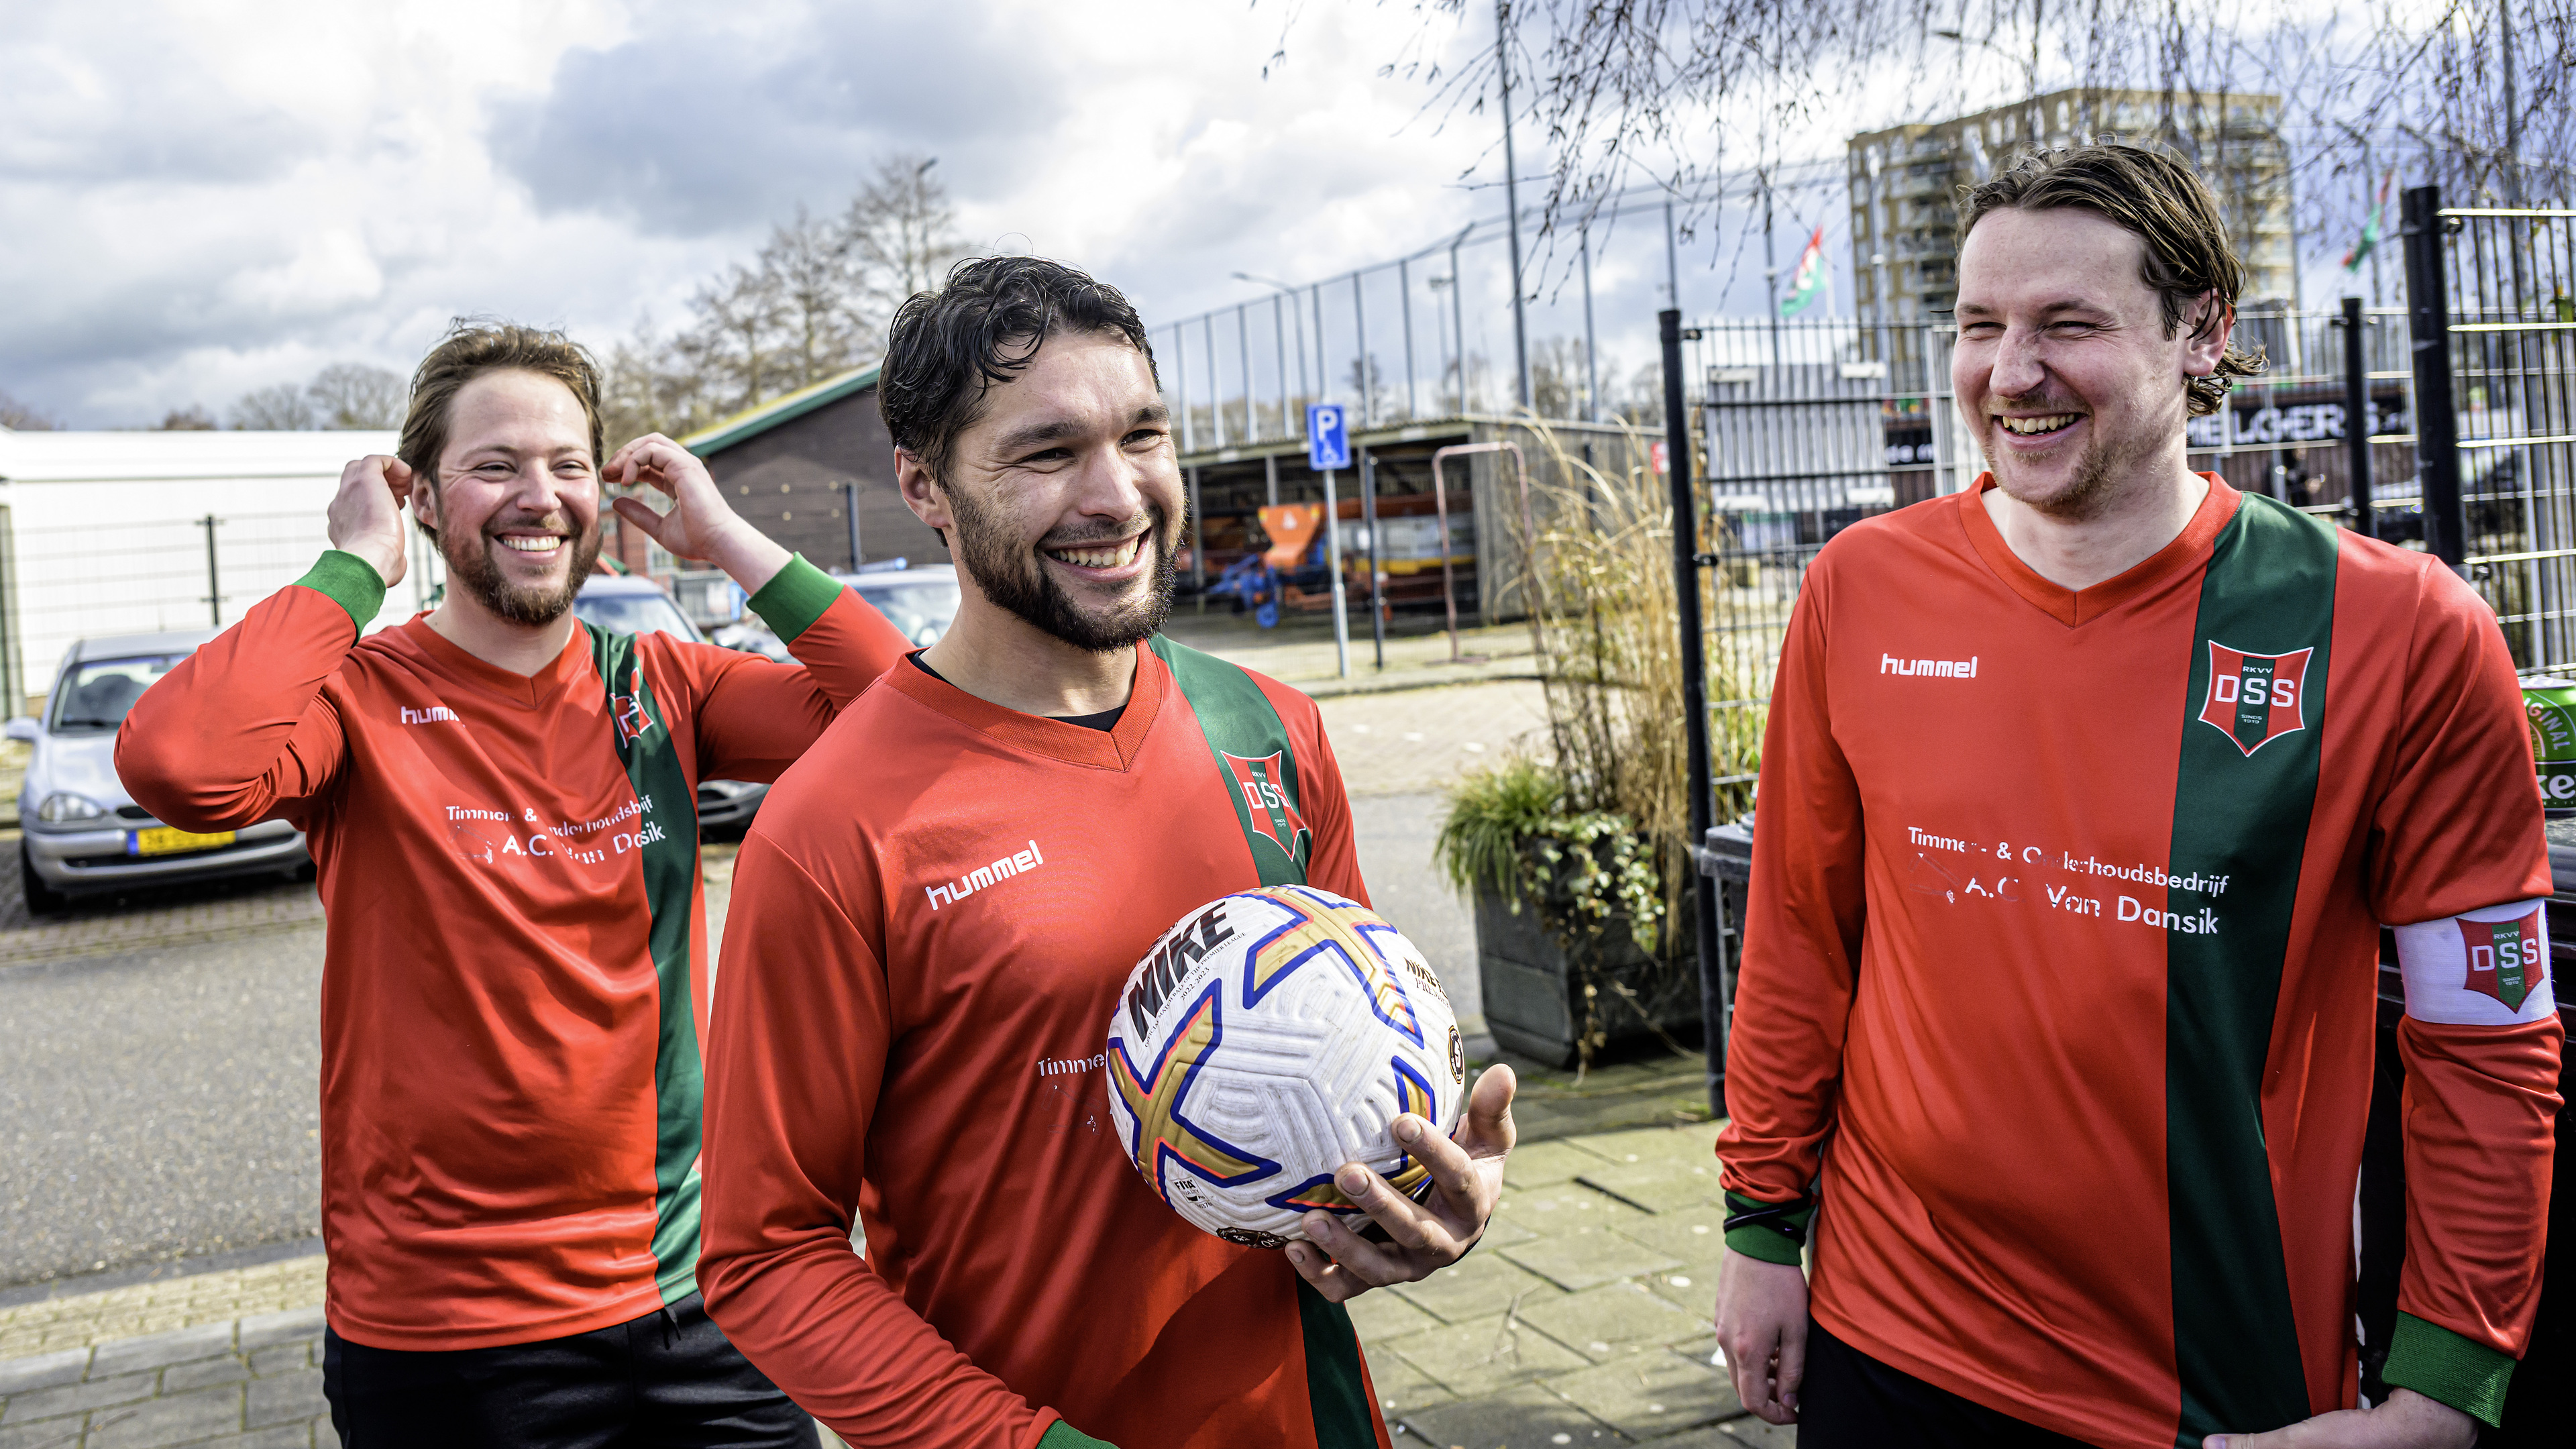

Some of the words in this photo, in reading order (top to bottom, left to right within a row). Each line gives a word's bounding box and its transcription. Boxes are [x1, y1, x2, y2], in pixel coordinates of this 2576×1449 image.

[1317, 410, 1338, 441] P
[1880, 653, 1978, 678] hummel
[2243, 665, 2273, 674] RKVV
[2215, 674, 2295, 708] DSS
[1243, 782, 1290, 809] DSS
[525, 808, 537, 822] &
[1996, 841, 2012, 861] &
[925, 840, 1044, 911] hummel
[2045, 883, 2100, 917] Van
[2117, 895, 2219, 934] Dansik
[2494, 930, 2520, 940] RKVV
[2471, 938, 2538, 972] DSS
[1128, 901, 1235, 1043] NIKE
[1180, 967, 1210, 1001] 2022-2023
[1144, 1019, 1159, 1048] OFFICIAL
[1158, 997, 1173, 1019] MATCH
[1172, 983, 1185, 998] BALL
[1183, 975, 1191, 983] OF
[1190, 964, 1201, 976] THE
[1200, 945, 1225, 965] PREMIER
[1224, 932, 1246, 947] LEAGUE
[1174, 1180, 1196, 1190] FIFA
